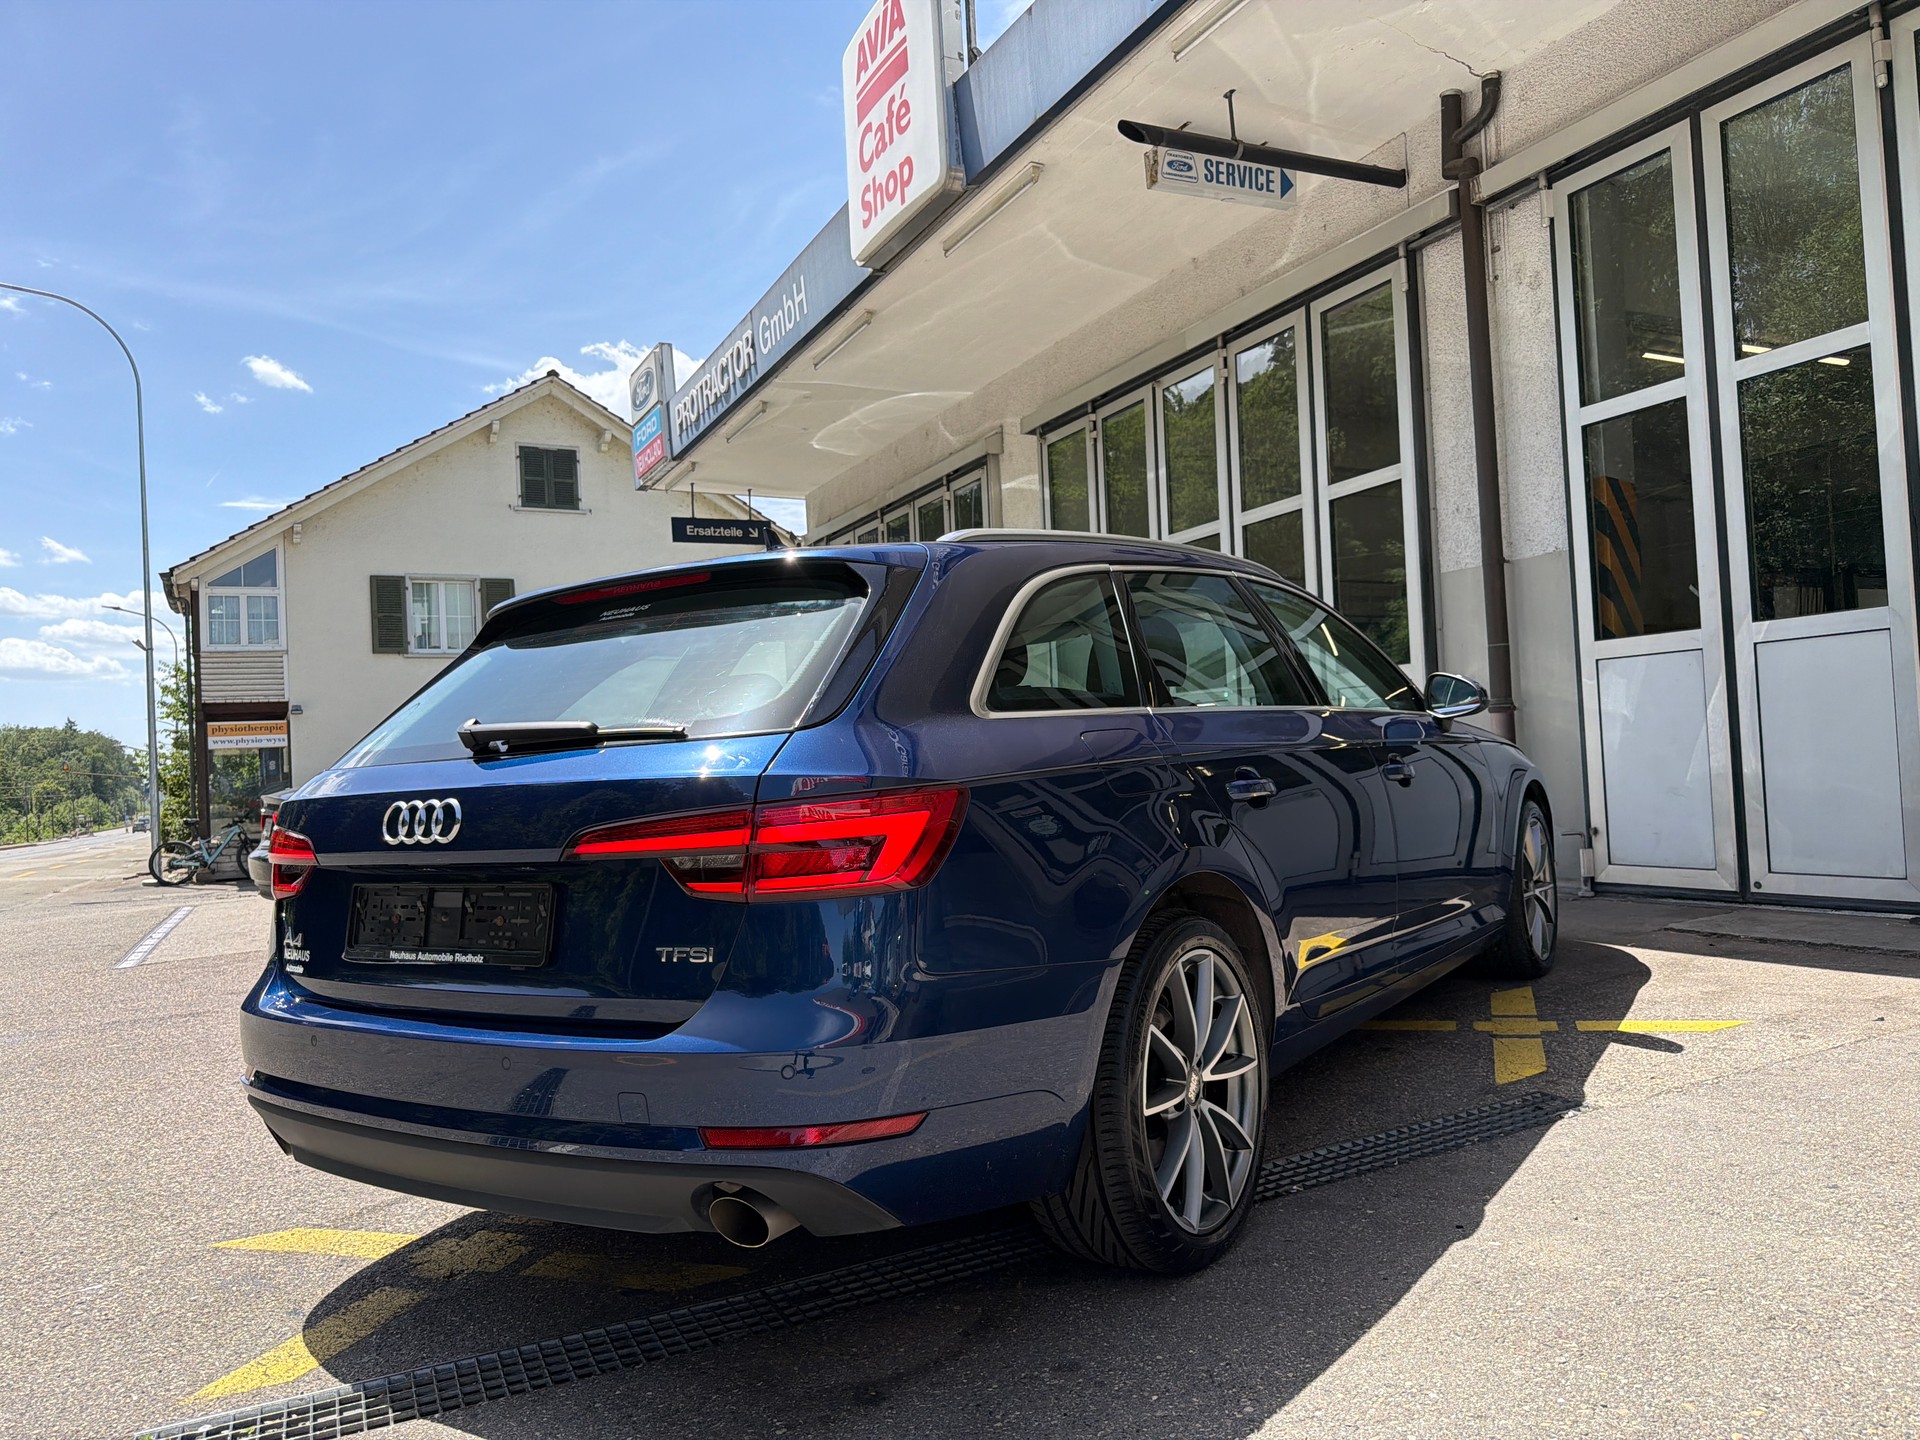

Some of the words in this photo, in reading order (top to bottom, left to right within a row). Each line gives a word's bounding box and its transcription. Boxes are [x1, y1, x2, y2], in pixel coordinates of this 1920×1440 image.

[859, 83, 911, 173] Café
[1170, 161, 1190, 171] Ford
[1203, 157, 1275, 194] SERVICE
[861, 155, 914, 229] Shop
[674, 328, 757, 438] PROTRACTOR
[758, 274, 809, 355] GmbH
[636, 415, 658, 447] FORD
[686, 524, 743, 537] Ersatzteile
[283, 926, 302, 947] A4
[389, 950, 417, 960] Neuhaus
[417, 951, 454, 962] Automobile
[454, 952, 484, 963] Riedholz
[655, 946, 714, 963] TFSI
